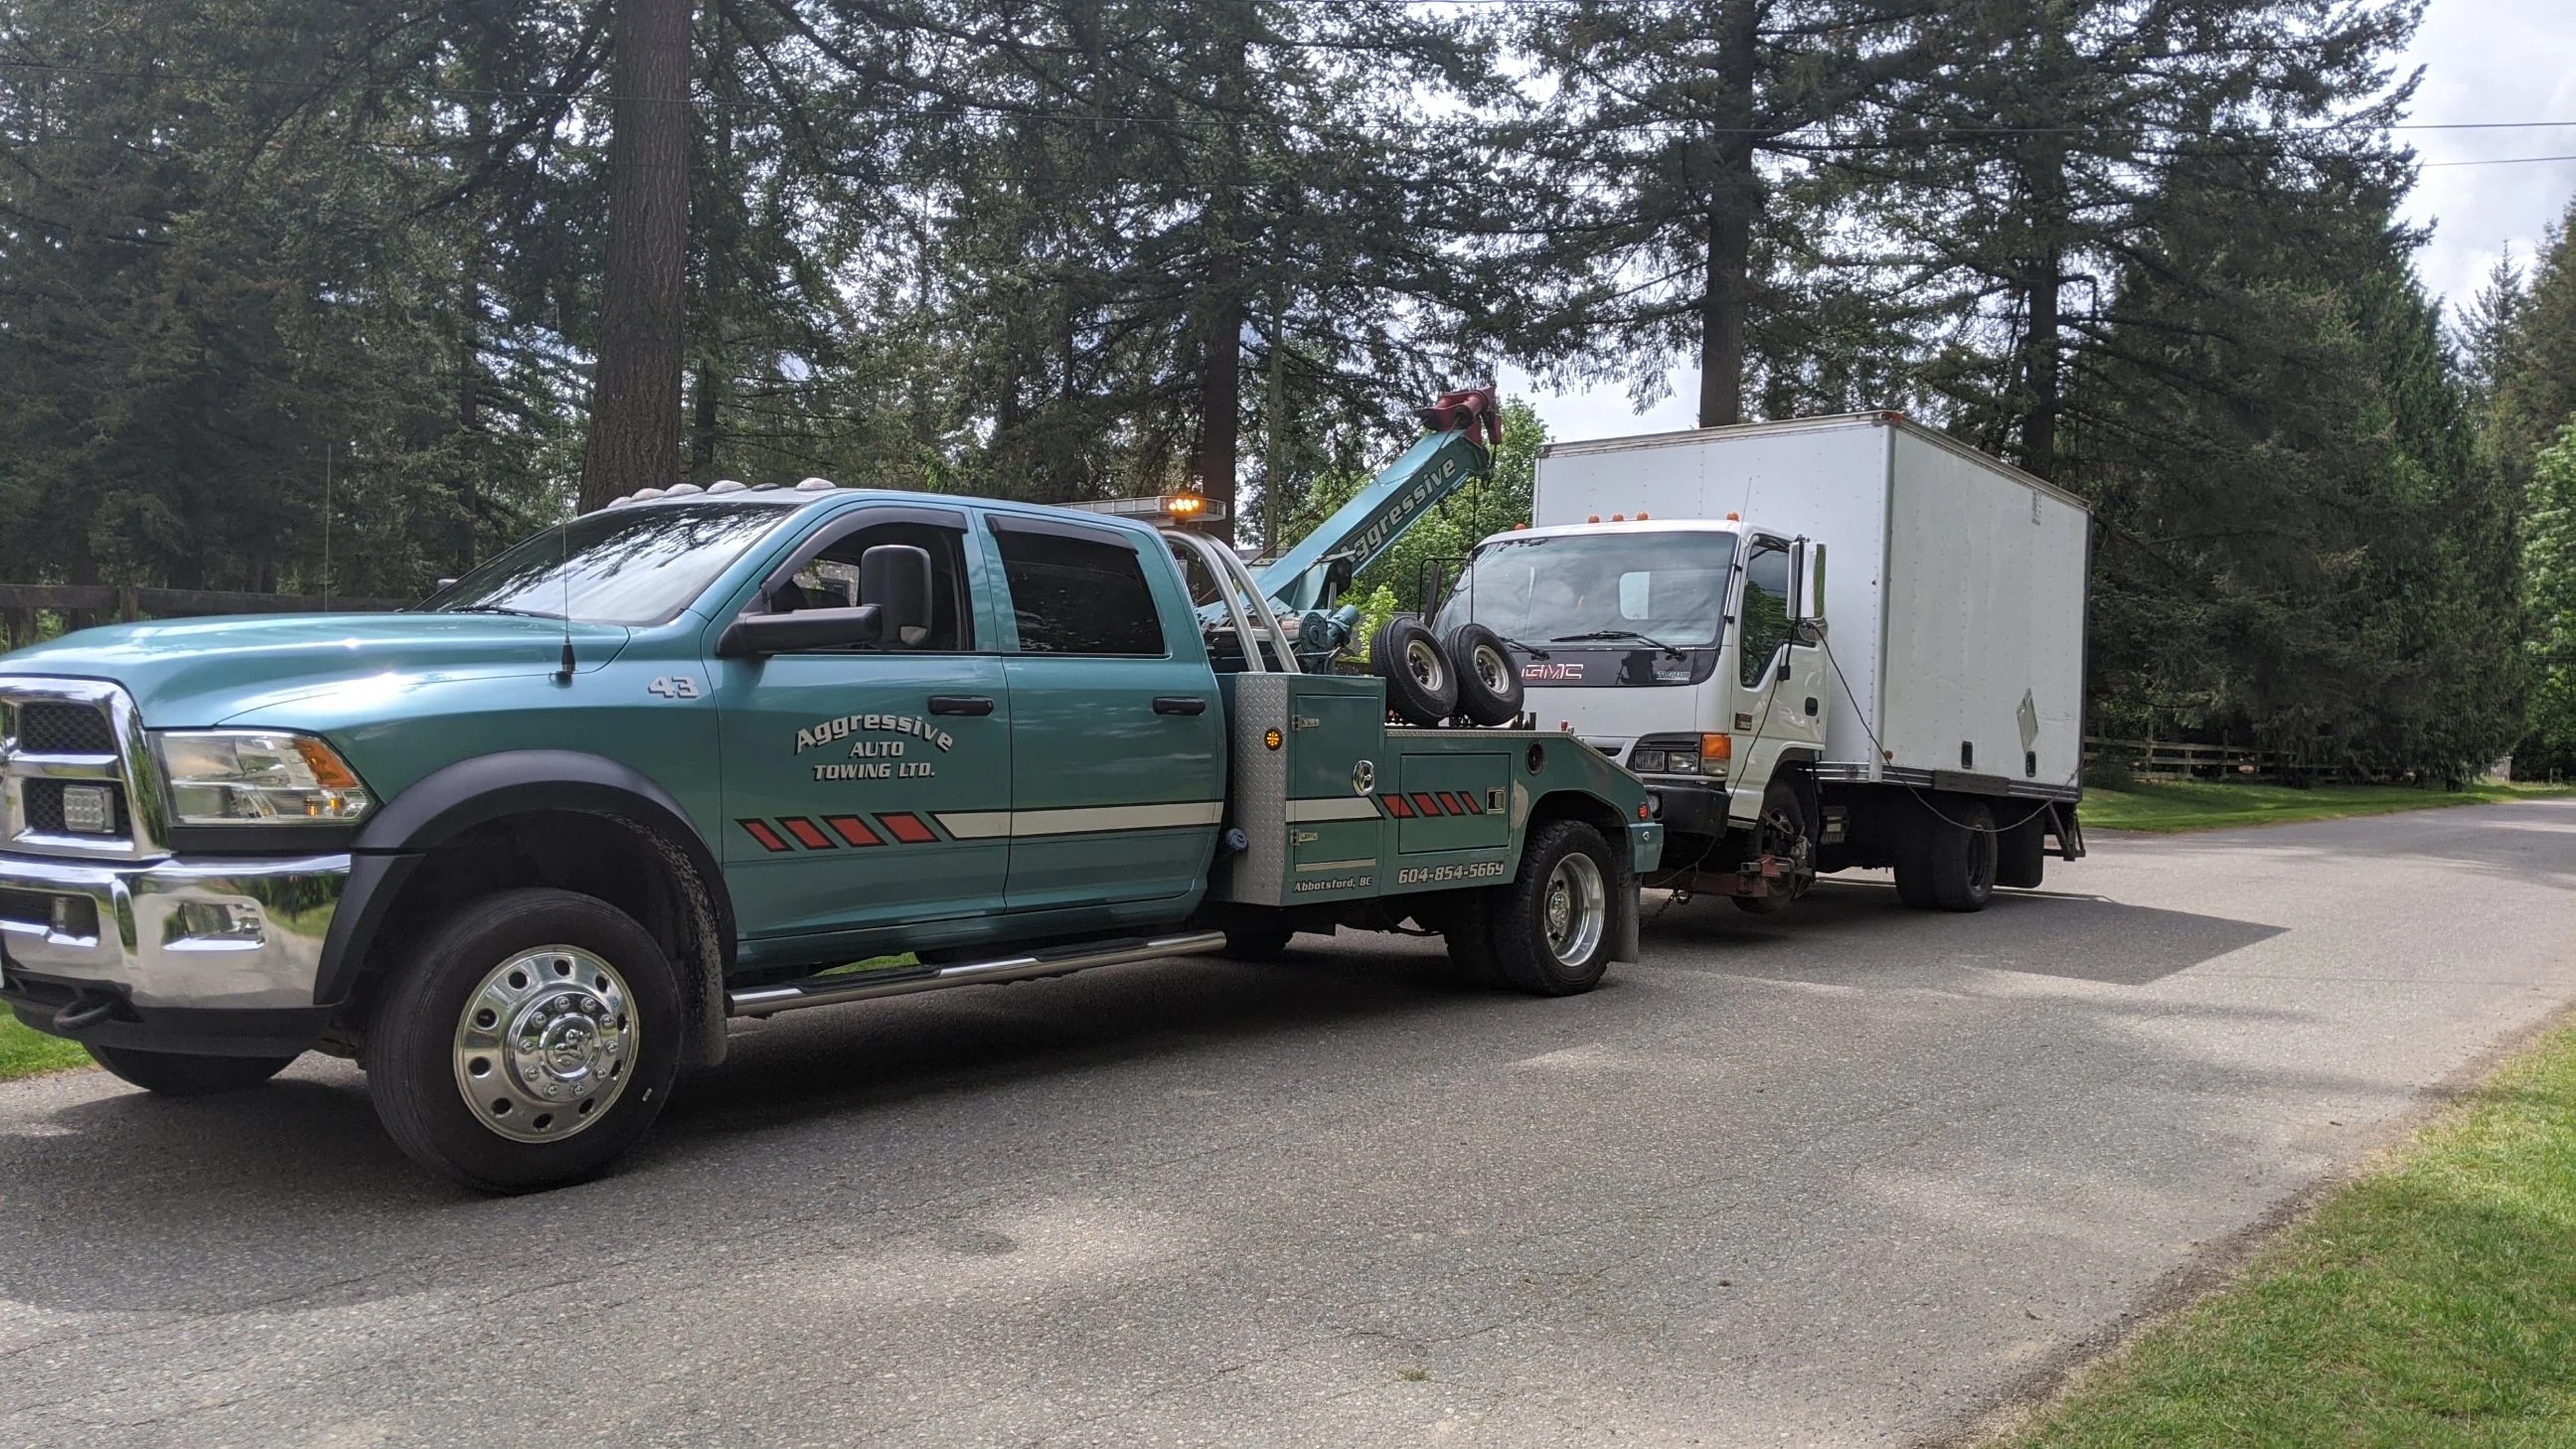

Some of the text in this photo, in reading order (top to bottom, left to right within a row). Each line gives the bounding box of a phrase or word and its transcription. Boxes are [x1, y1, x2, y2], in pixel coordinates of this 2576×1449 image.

[1522, 663, 1584, 680] GMC
[648, 676, 700, 699] 43
[796, 714, 954, 753] Aggressive
[849, 741, 904, 757] AUTO
[814, 762, 936, 780] TOWING LTD.
[1397, 862, 1505, 885] 604-854-5669
[1293, 876, 1372, 892] Abbotsford, BC
